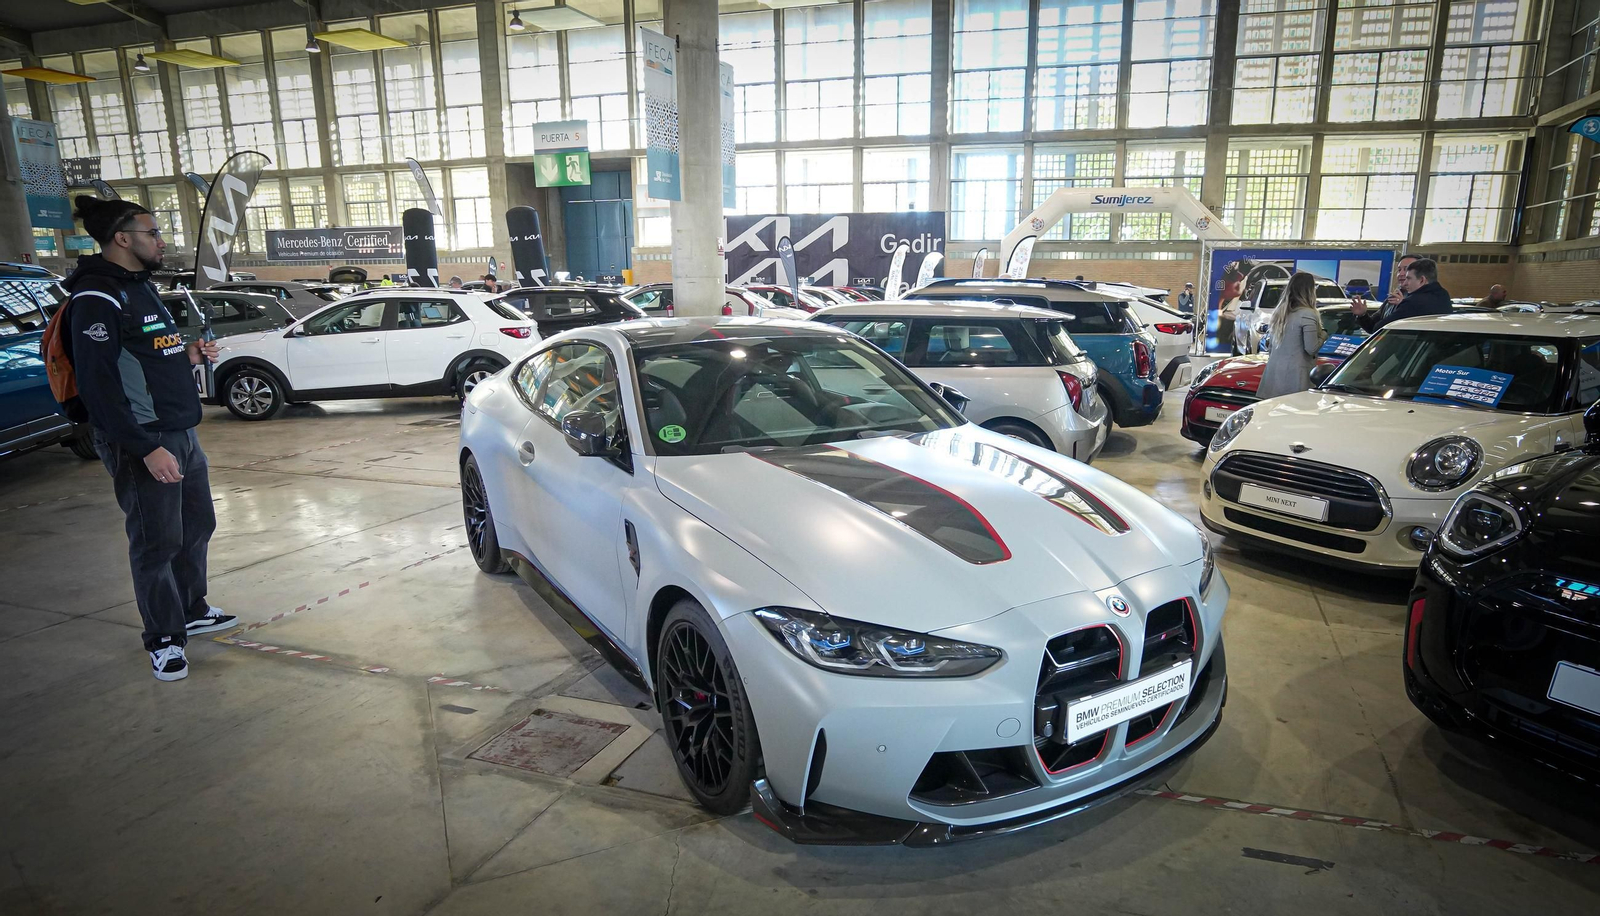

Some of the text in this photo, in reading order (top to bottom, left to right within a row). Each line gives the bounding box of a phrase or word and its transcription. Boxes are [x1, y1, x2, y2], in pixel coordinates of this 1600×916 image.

[645, 41, 673, 62] IFECA
[16, 126, 53, 139] IFECA
[541, 133, 570, 143] PUERTA
[277, 234, 389, 249] Mercedes-Benz Certified
[1265, 495, 1297, 508] MINI NEXT
[1076, 673, 1185, 723] BMW PREMIUM SELECTION
[1110, 699, 1147, 718] SEMINUEVOS
[1147, 684, 1184, 703] CERTIFICADOS
